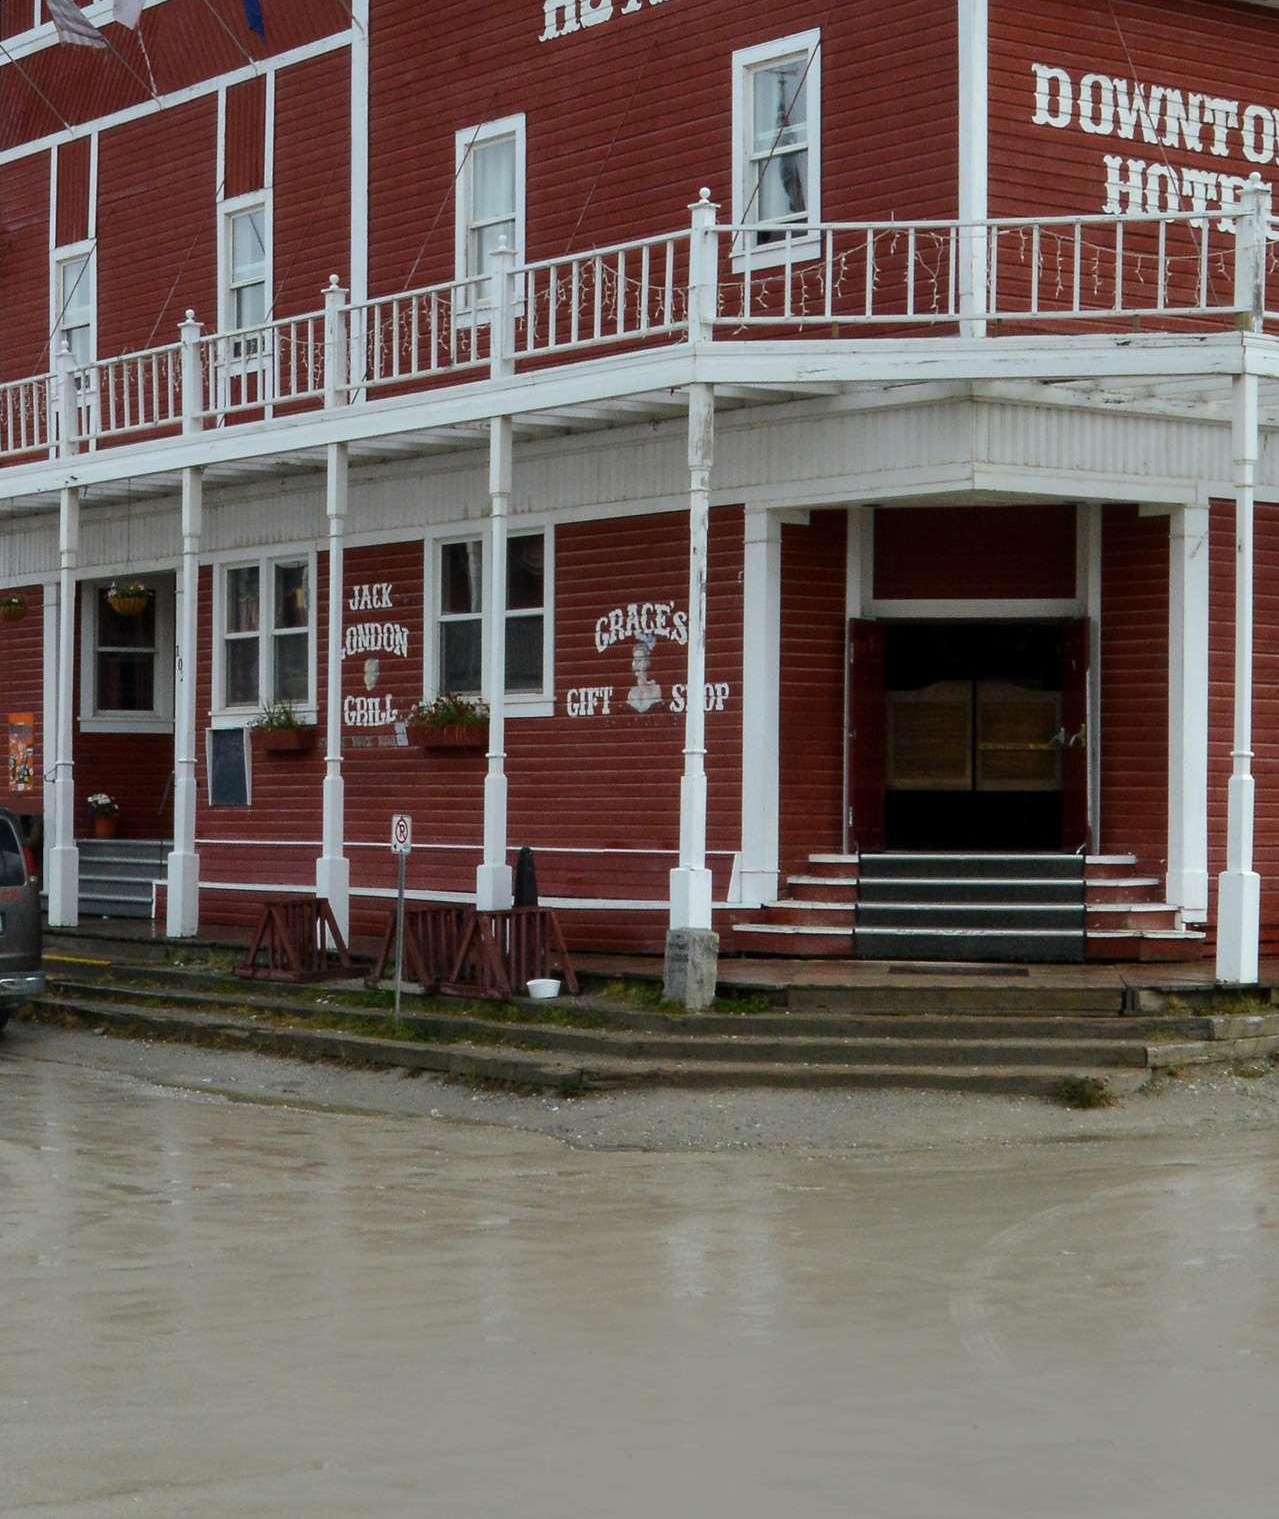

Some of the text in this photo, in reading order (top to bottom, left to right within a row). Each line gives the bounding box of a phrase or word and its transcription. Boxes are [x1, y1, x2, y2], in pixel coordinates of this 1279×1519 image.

[348, 582, 394, 611] JACK
[341, 622, 409, 660] ONDON
[595, 601, 688, 653] GRACE'S
[343, 693, 398, 727] GRILL
[566, 682, 729, 717] GIFT SOP
